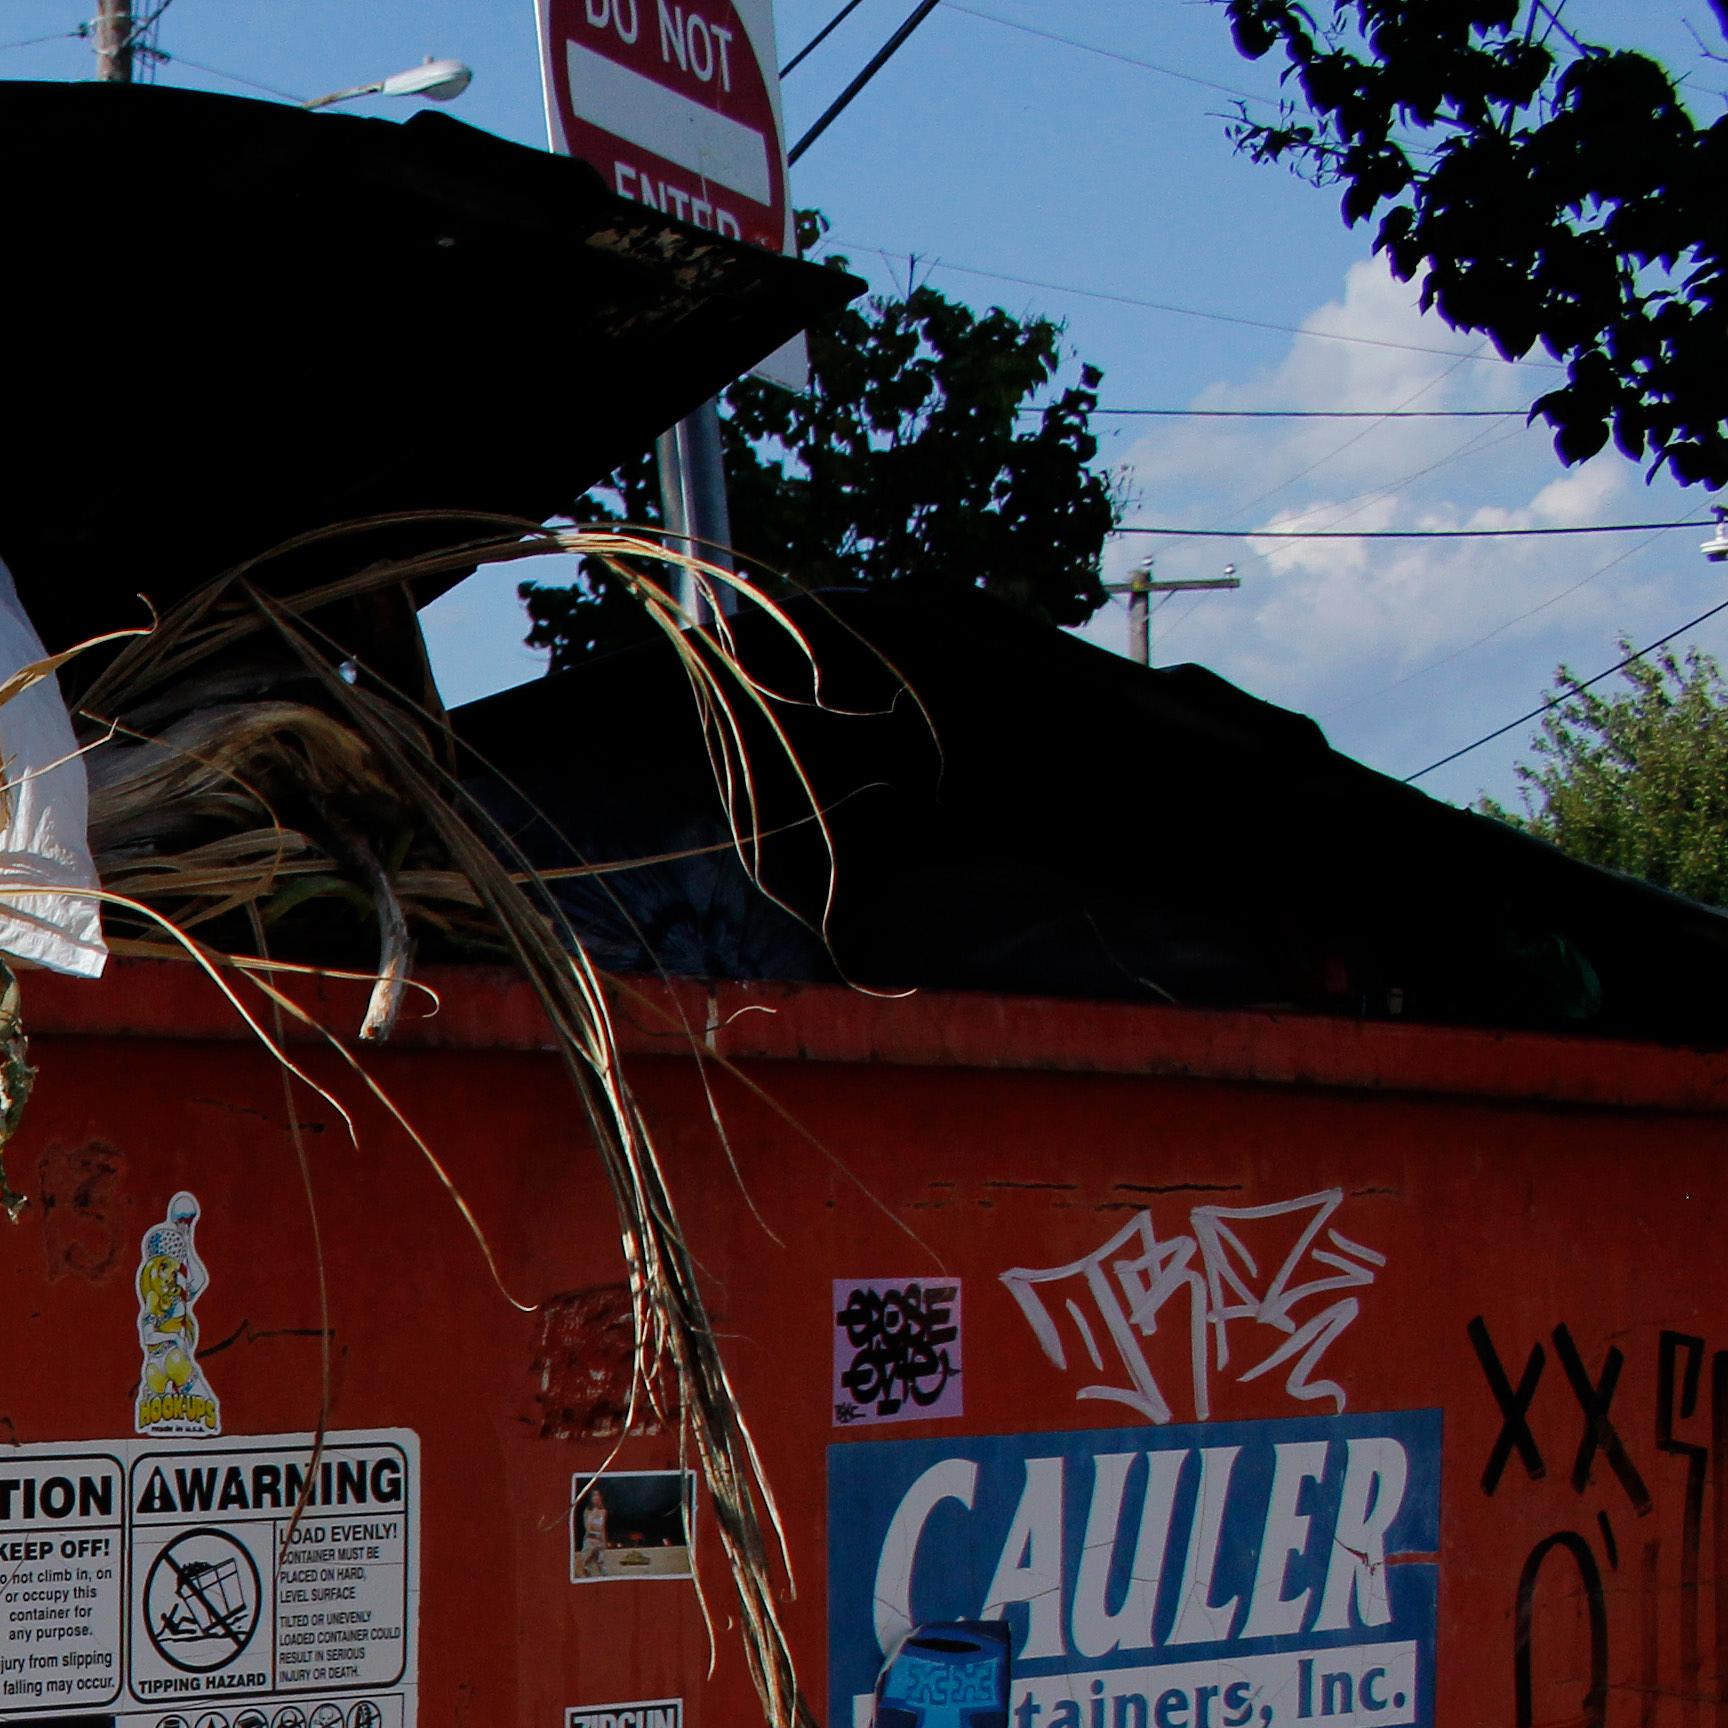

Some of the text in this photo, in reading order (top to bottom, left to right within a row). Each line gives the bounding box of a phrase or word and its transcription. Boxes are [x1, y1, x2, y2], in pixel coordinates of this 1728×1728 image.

[656, 0, 732, 93] NOT
[140, 1394, 216, 1429] HOOK-UPS
[174, 1457, 402, 1512] WARNING
[280, 1523, 397, 1545] LOAD EVENLY!
[60, 1538, 109, 1559] OFF!
[281, 1546, 380, 1565] CONTAINER MUST BE
[873, 1437, 1408, 1659] CAULER
[12, 1570, 33, 1584] not
[38, 1568, 72, 1582] climb
[76, 1568, 92, 1582] in,
[96, 1568, 112, 1580] on
[280, 1569, 317, 1584] PLACED
[320, 1569, 335, 1582] ON
[5, 1586, 97, 1603] or occupy this
[280, 1586, 356, 1603] LEVEL SURFACE
[9, 1605, 92, 1622] container for
[280, 1610, 372, 1628] TILTED OR UNEVENLY
[9, 1625, 93, 1642] any purpose.
[280, 1627, 401, 1646] LOADED CONTAINER COULD
[29, 1654, 58, 1669] from
[62, 1650, 112, 1669] slipping
[279, 1647, 365, 1664] RESULT IN SERIOUS
[139, 1673, 266, 1694] TIPPING HAZARD
[279, 1669, 310, 1682] INJURY
[312, 1668, 326, 1680] OR
[3, 1680, 42, 1696] falling
[46, 1679, 73, 1694] may
[77, 1677, 115, 1690] occur.
[1298, 1658, 1407, 1719] Inc.
